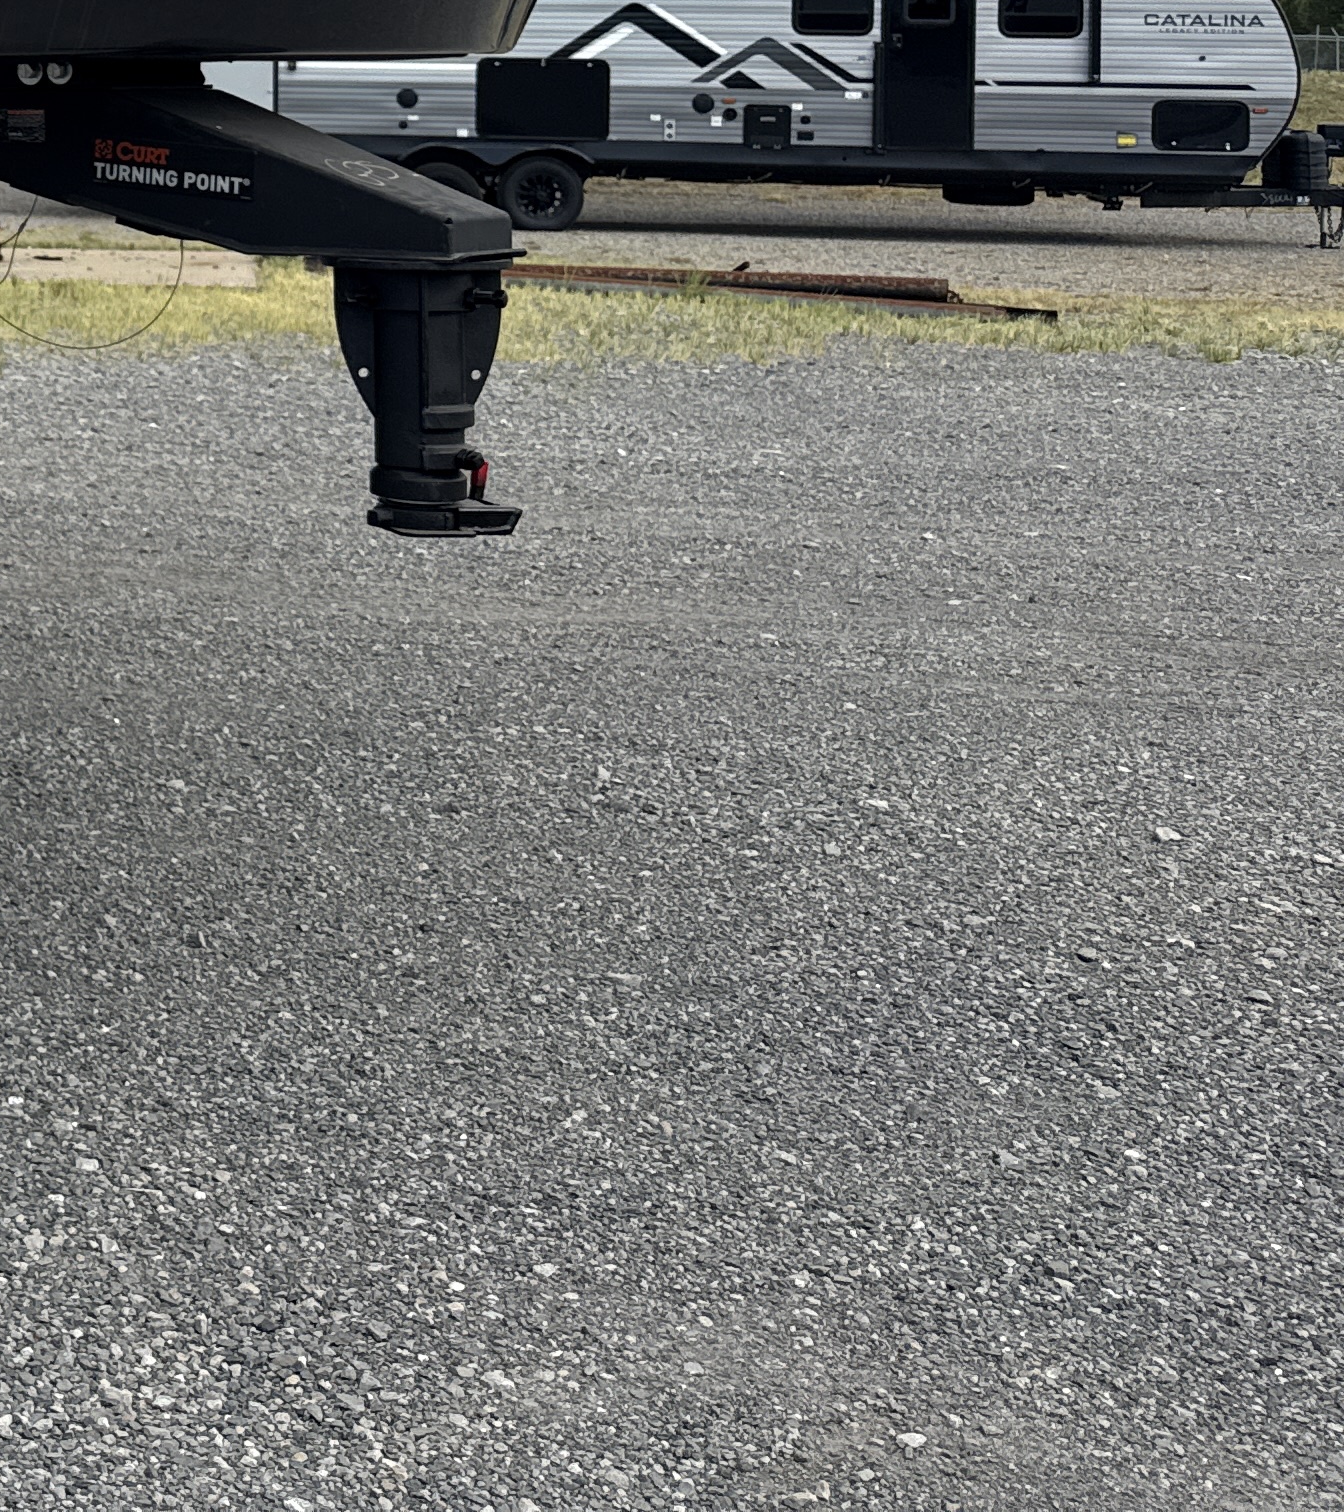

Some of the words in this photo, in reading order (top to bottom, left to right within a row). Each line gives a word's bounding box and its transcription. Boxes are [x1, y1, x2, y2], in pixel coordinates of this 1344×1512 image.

[1143, 13, 1265, 28] CATALINA
[1158, 27, 1199, 35] LEGACY
[116, 141, 170, 165] CURT
[93, 161, 179, 188] TURNING
